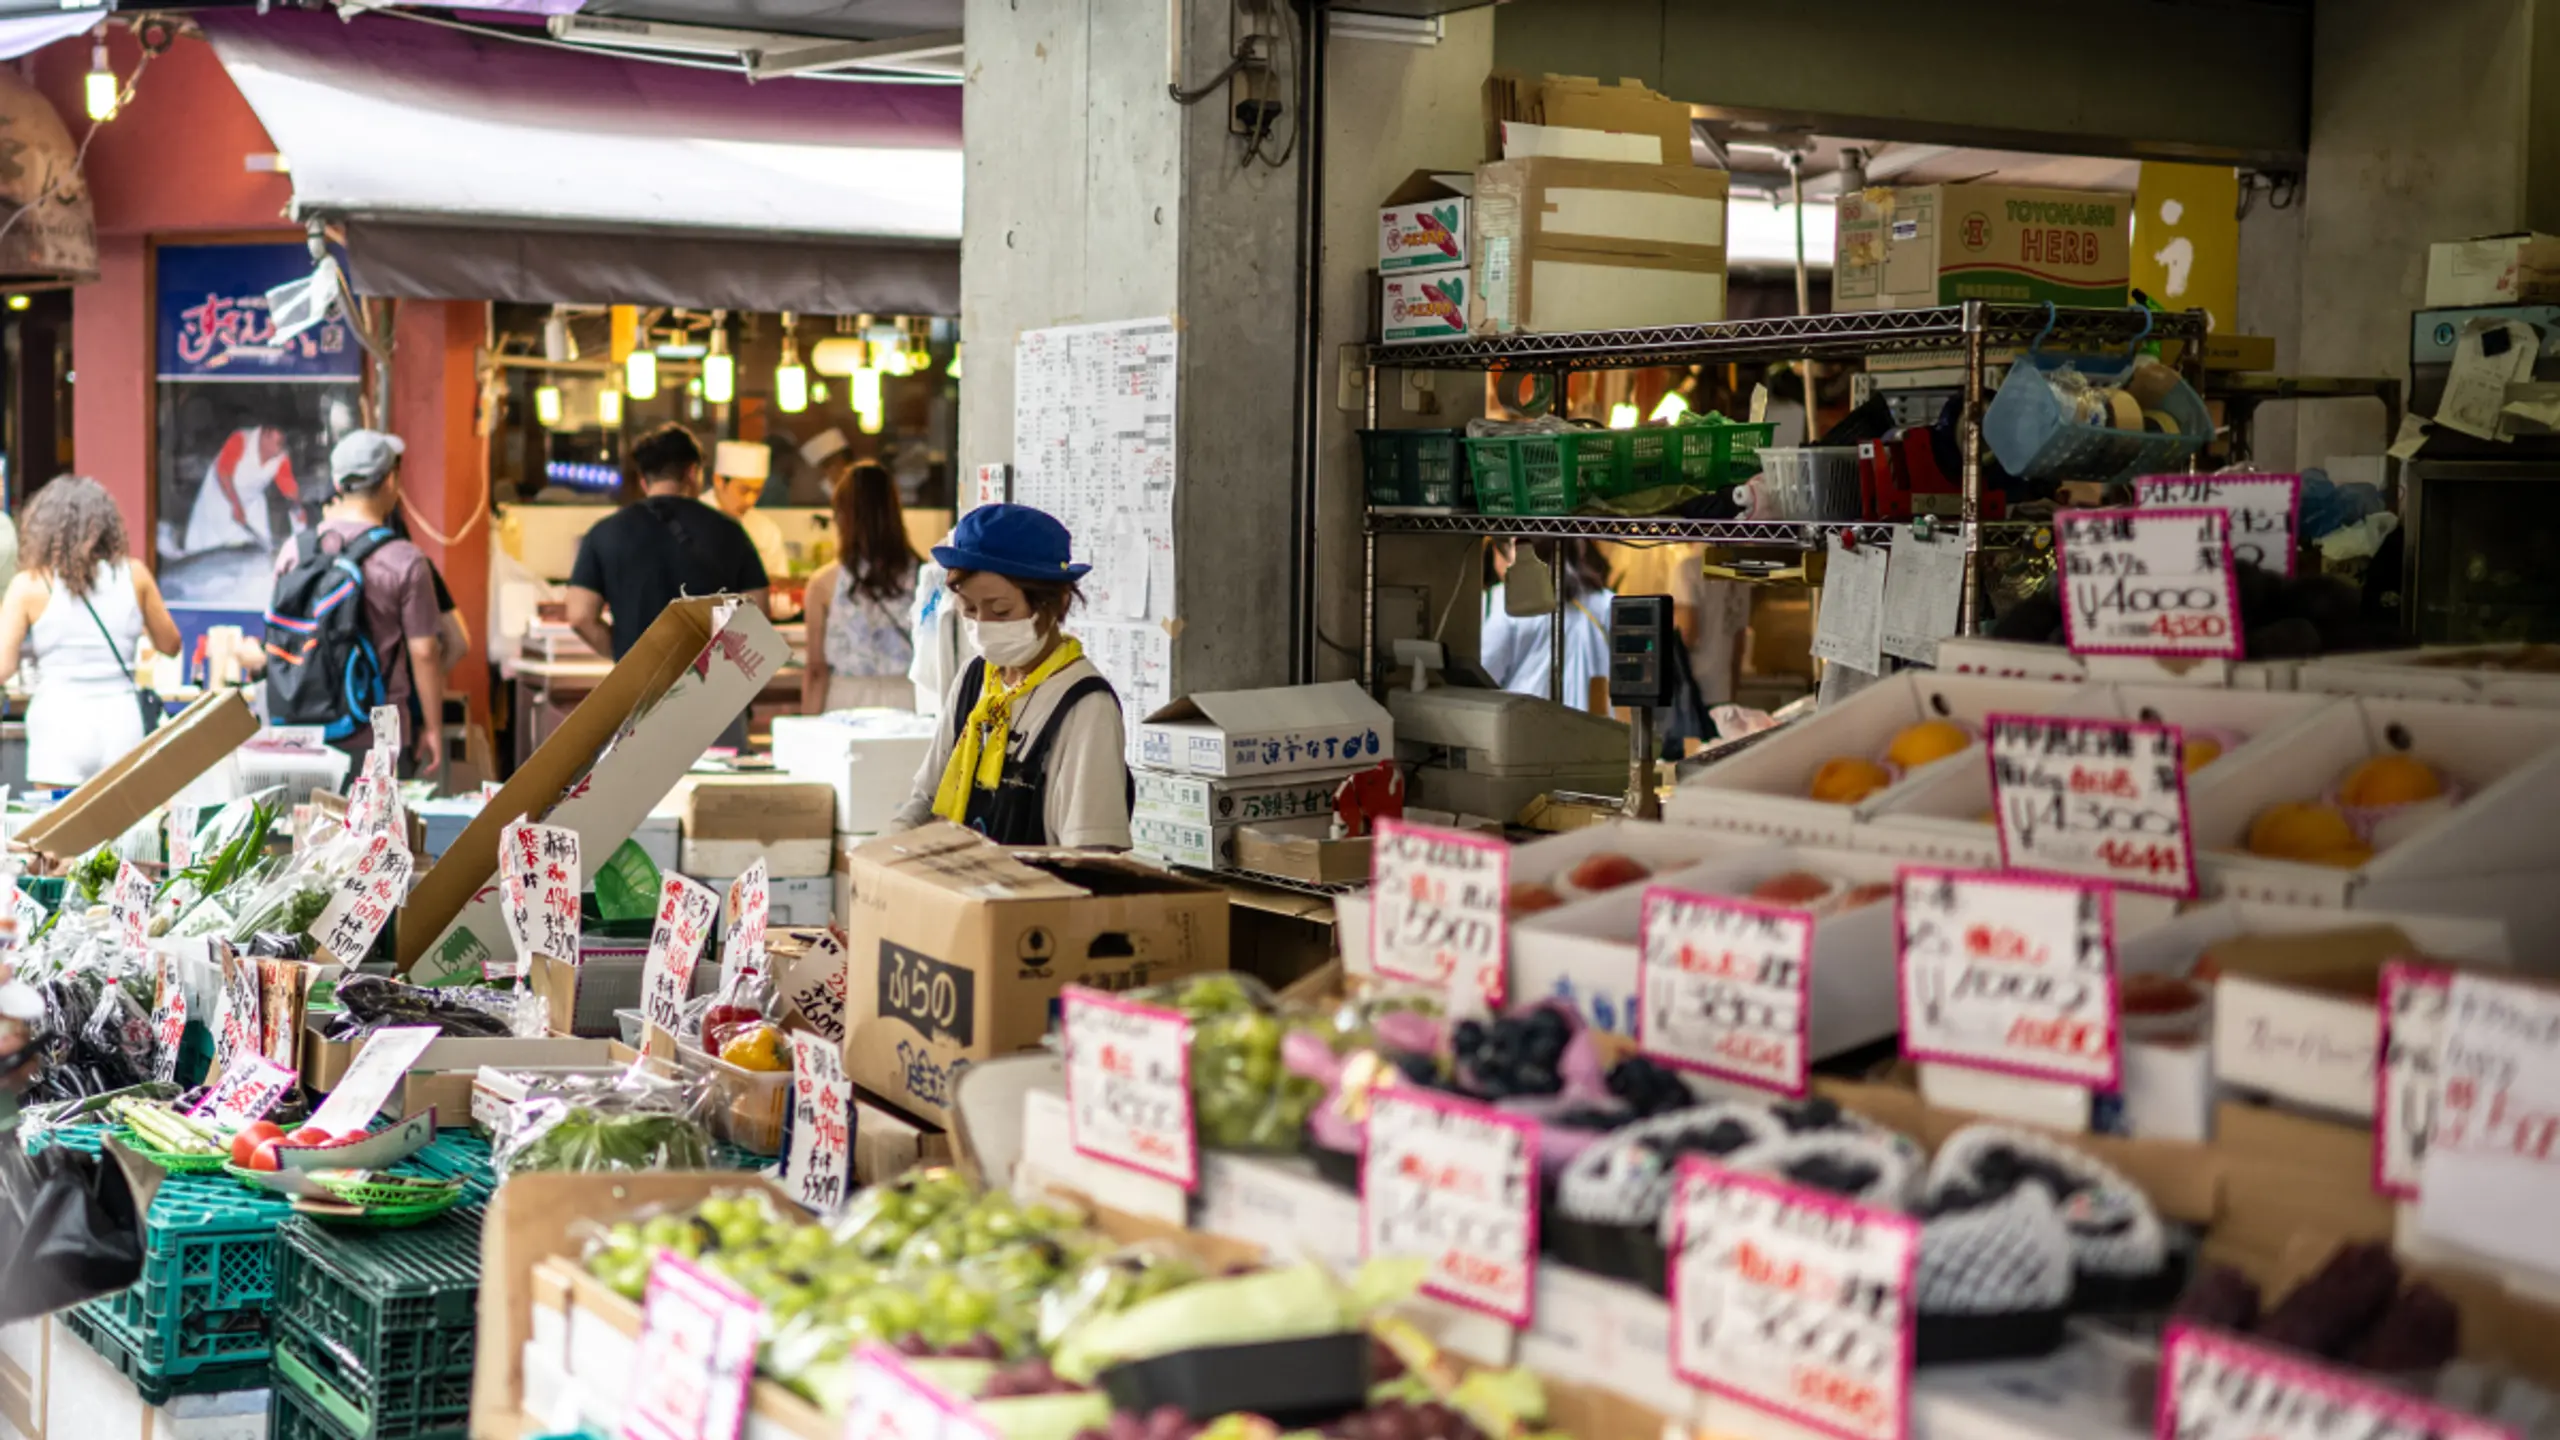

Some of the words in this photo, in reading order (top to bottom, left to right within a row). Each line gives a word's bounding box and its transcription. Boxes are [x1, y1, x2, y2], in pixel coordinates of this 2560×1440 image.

[2006, 199, 2117, 227] TOYOHASHI
[2022, 228, 2100, 265] HERB
[2077, 578, 2218, 631] ¥4000
[888, 952, 957, 1028] ふらの
